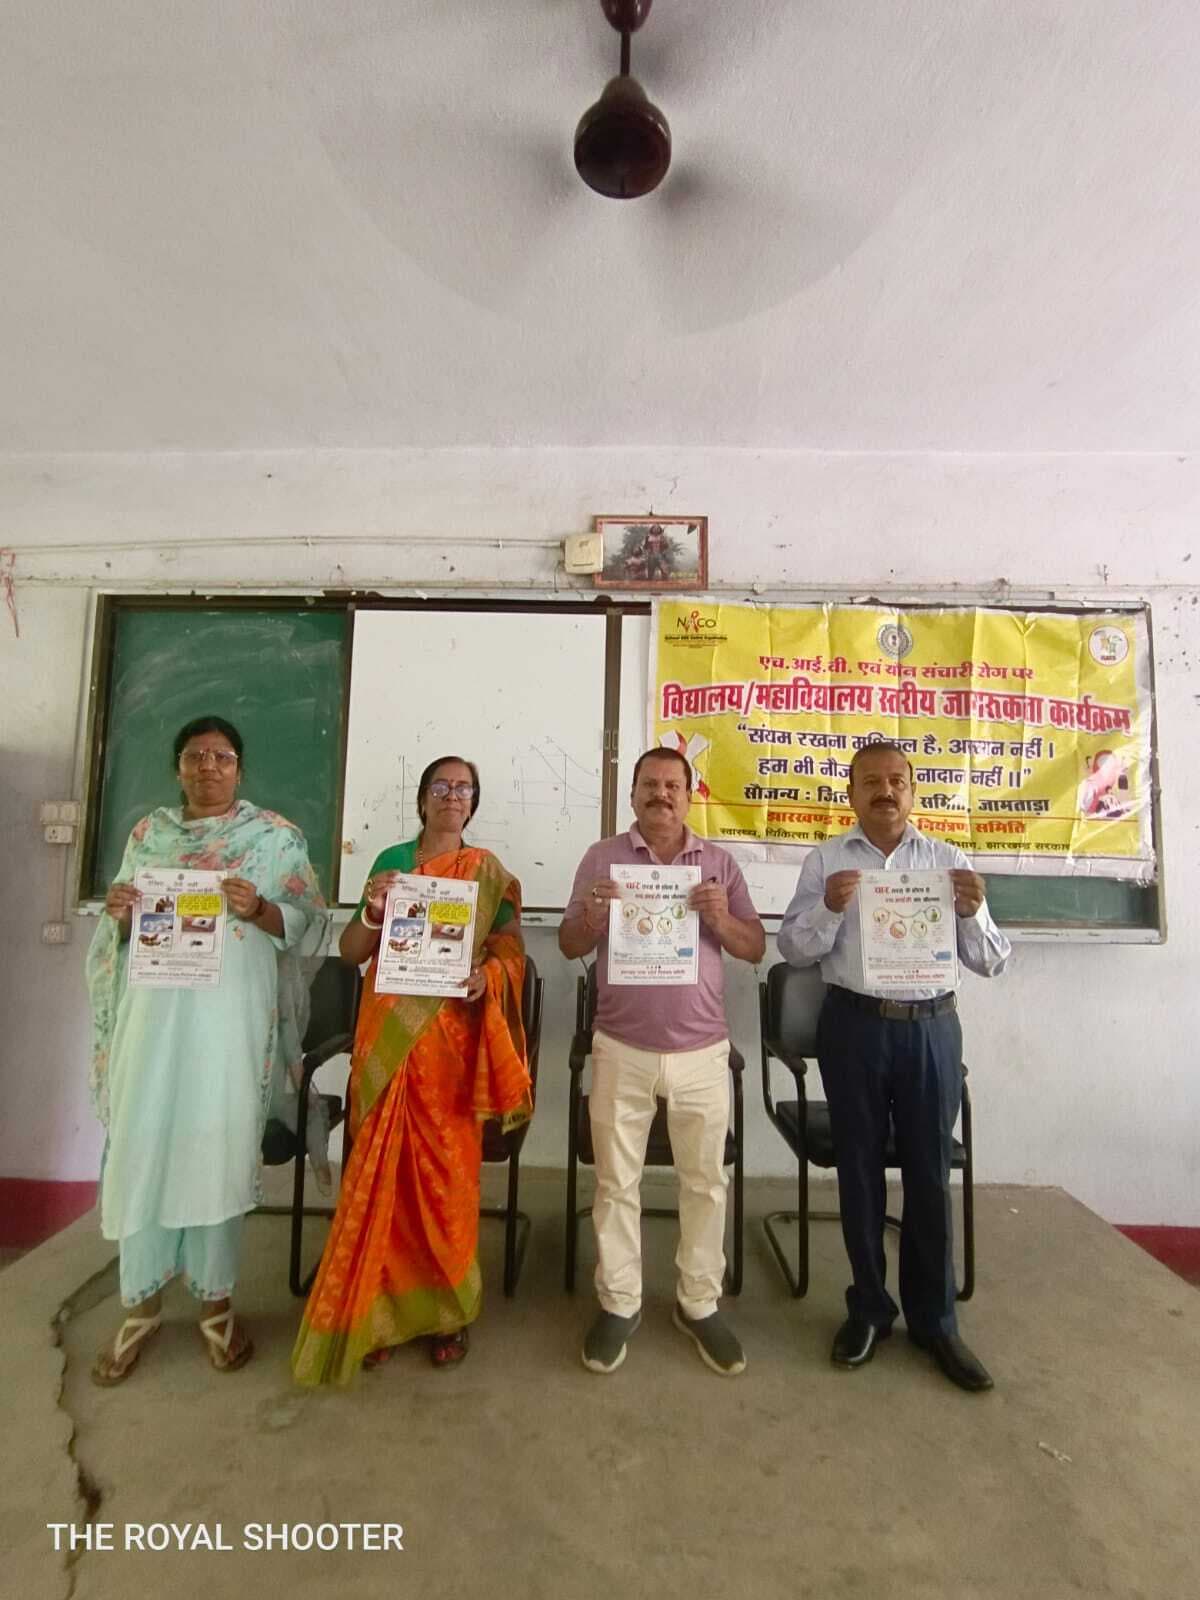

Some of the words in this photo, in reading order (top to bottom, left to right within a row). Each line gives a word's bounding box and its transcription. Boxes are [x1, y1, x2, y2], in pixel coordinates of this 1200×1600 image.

[922, 661, 973, 678] संचारी
[978, 661, 1008, 678] रोग
[1011, 666, 1034, 679] पर
[878, 681, 936, 715] स्तरीय
[796, 732, 847, 749] रखना
[1010, 738, 1042, 758] नहीं
[758, 758, 788, 774] हम
[794, 756, 814, 774] भी
[971, 766, 1003, 787] नहीं
